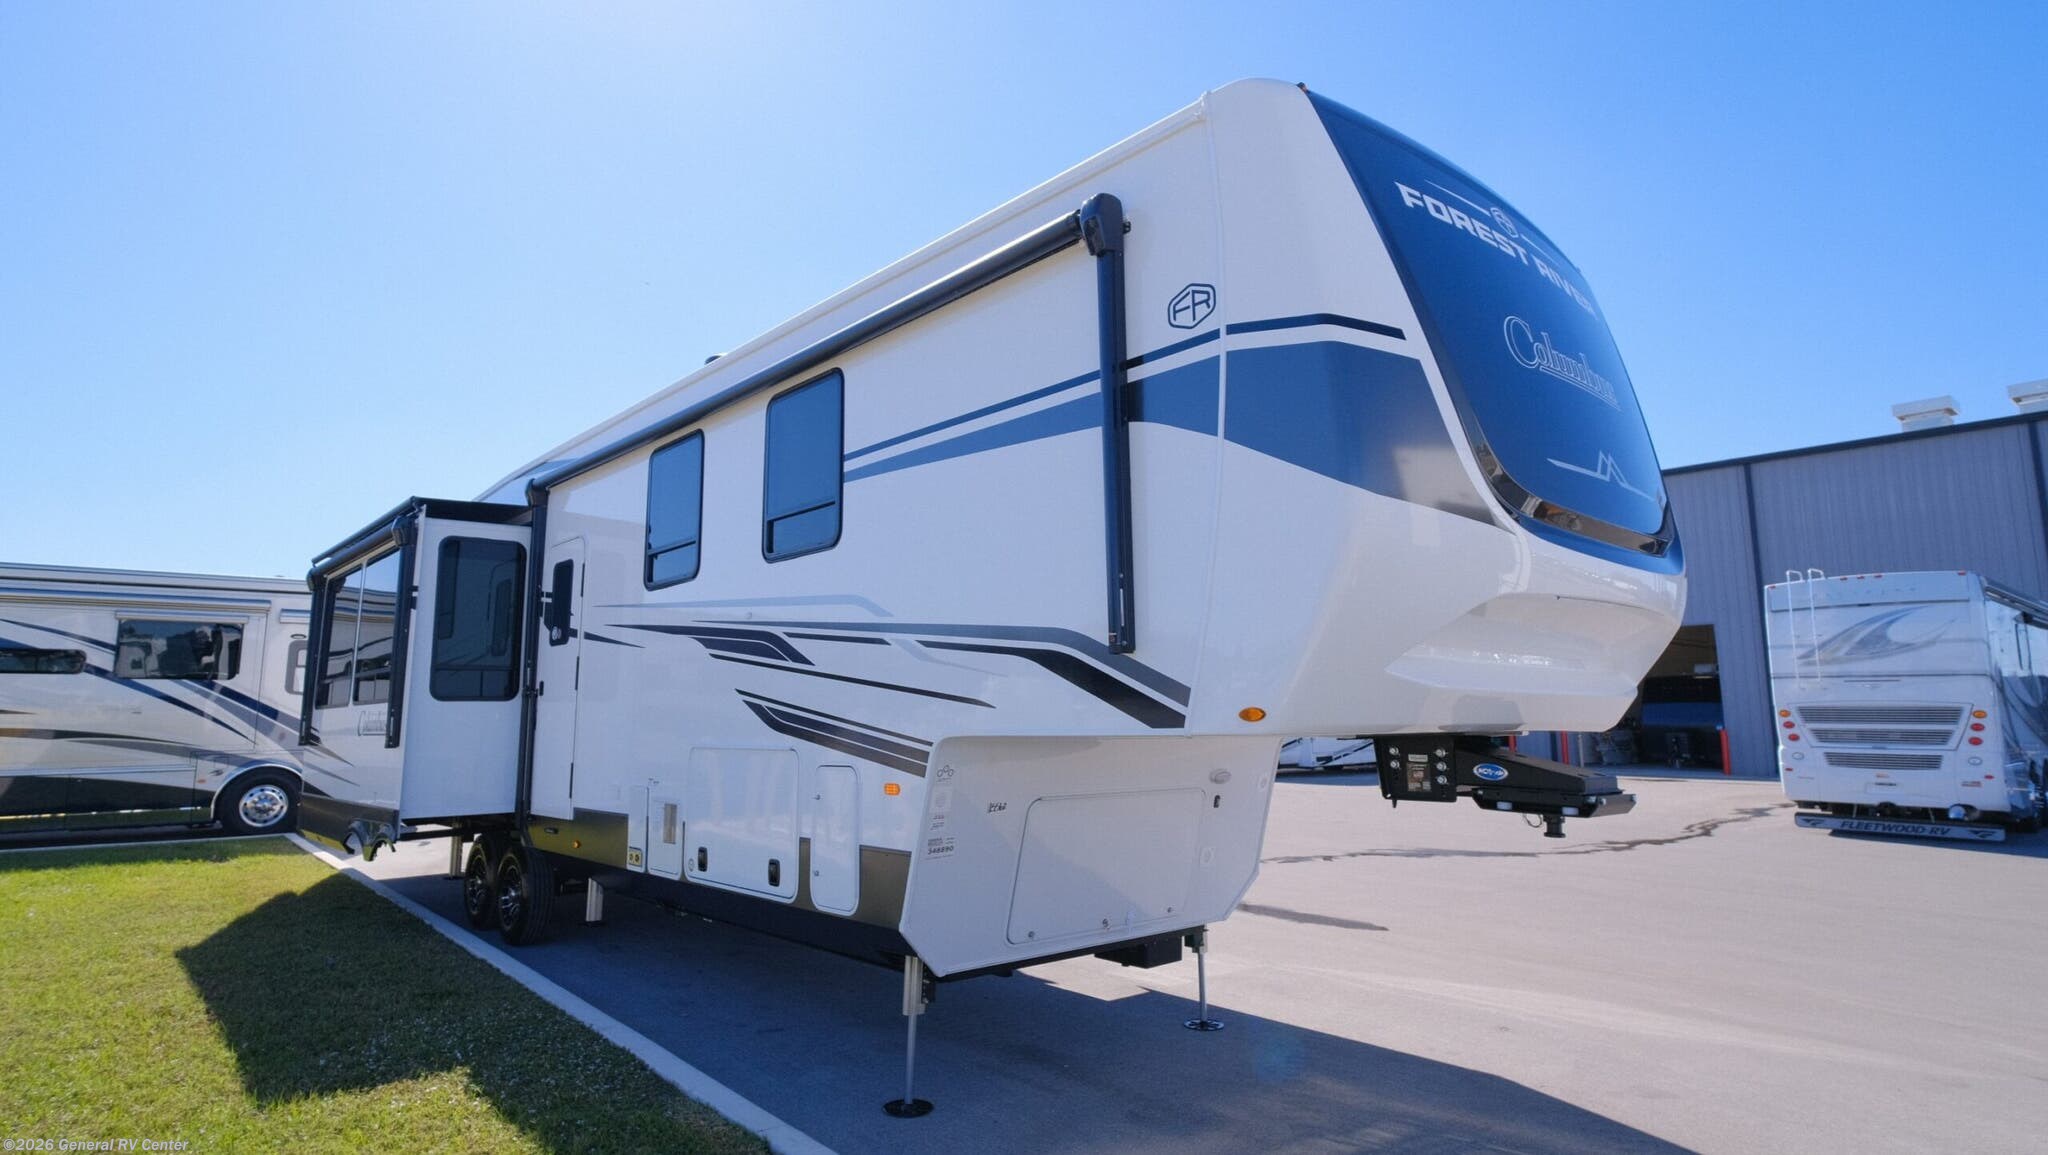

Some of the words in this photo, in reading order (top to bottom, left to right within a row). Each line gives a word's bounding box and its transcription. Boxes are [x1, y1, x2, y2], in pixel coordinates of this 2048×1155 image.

[1394, 181, 1528, 265] FOREST
[1840, 820, 1926, 834] FLEETWOOD
[1929, 827, 1951, 835] RV
